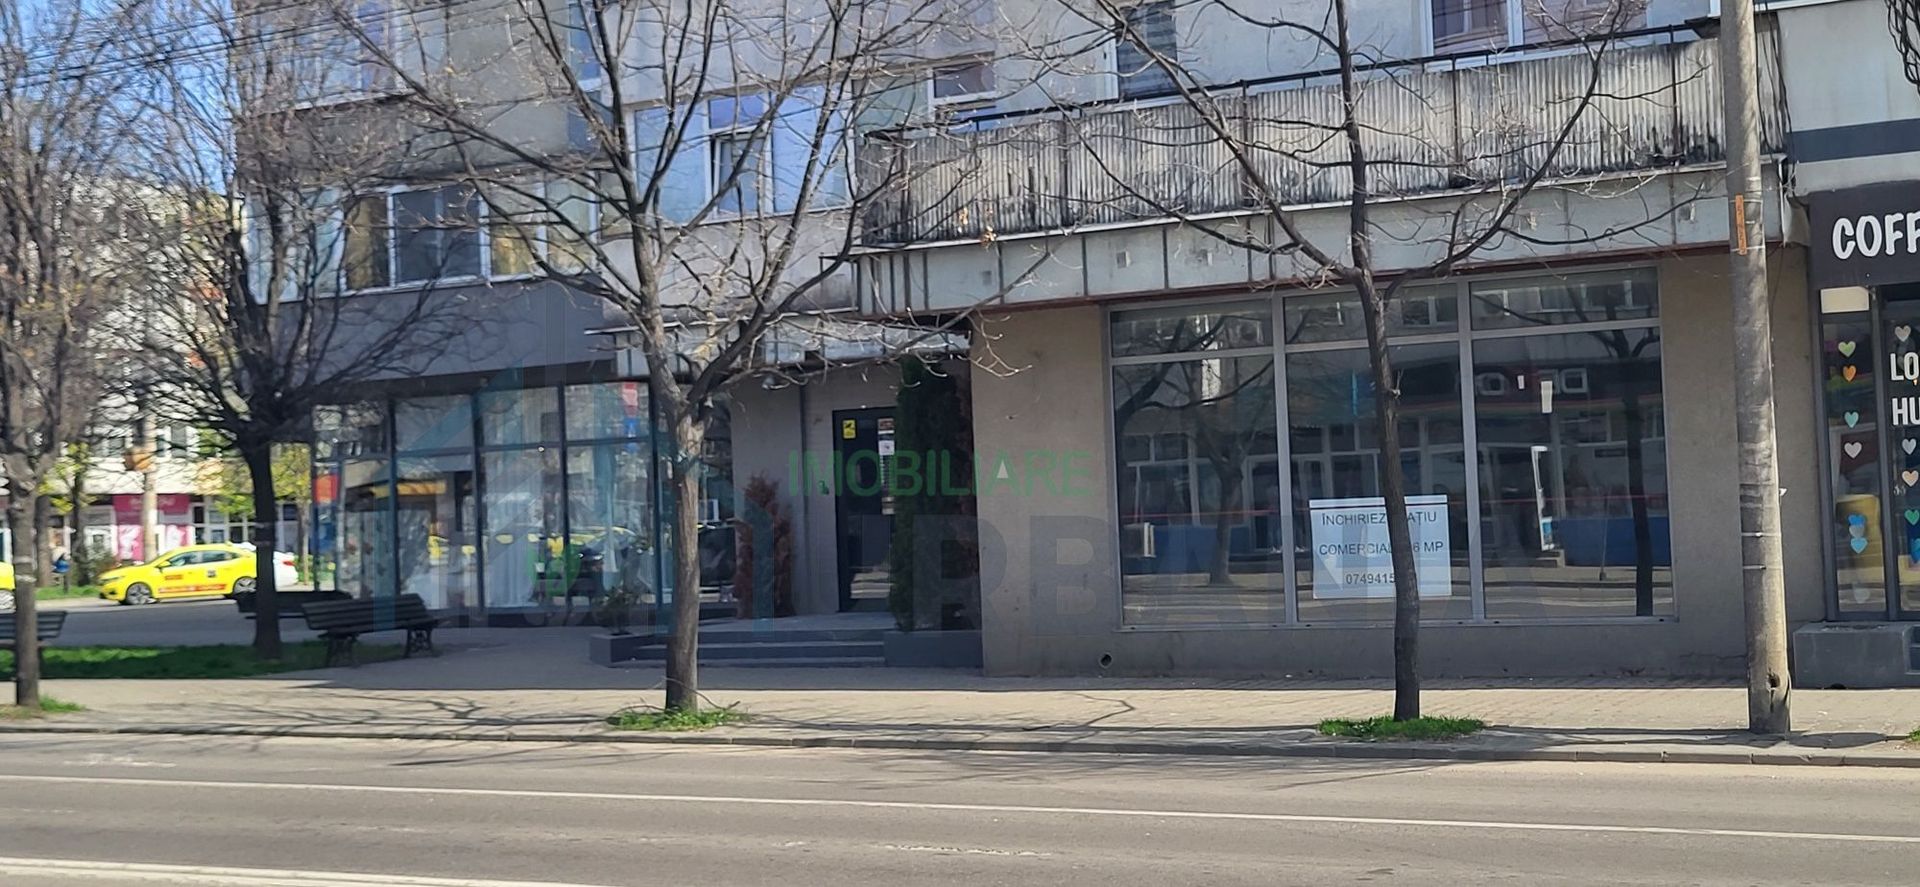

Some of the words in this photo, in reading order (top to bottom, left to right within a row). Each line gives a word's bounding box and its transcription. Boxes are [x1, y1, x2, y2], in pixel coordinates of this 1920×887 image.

[1322, 512, 1386, 526] ÎNCHIRIEZ
[1424, 540, 1444, 553] MP
[1345, 573, 1396, 585] 0749415
